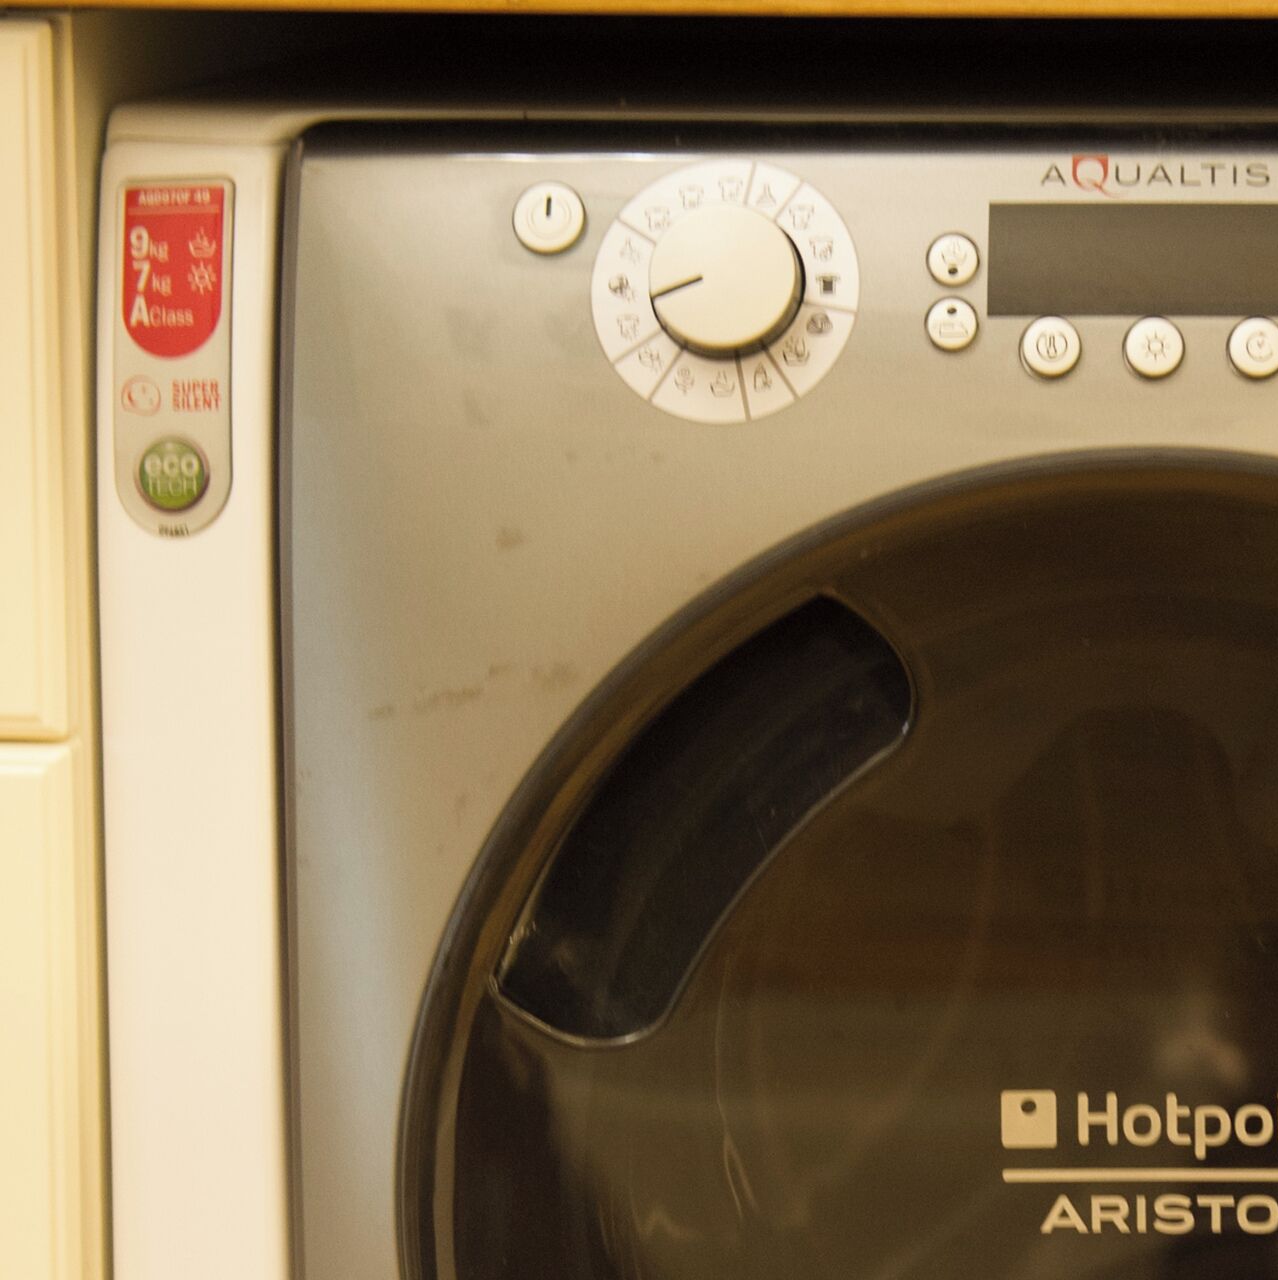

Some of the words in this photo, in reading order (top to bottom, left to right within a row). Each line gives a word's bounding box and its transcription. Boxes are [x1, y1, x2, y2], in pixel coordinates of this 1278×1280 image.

[1041, 155, 1271, 197] AQUALTIS
[172, 379, 219, 394] SUPER
[172, 395, 221, 412] SILENT
[144, 453, 199, 478] eco
[148, 476, 198, 497] TECH
